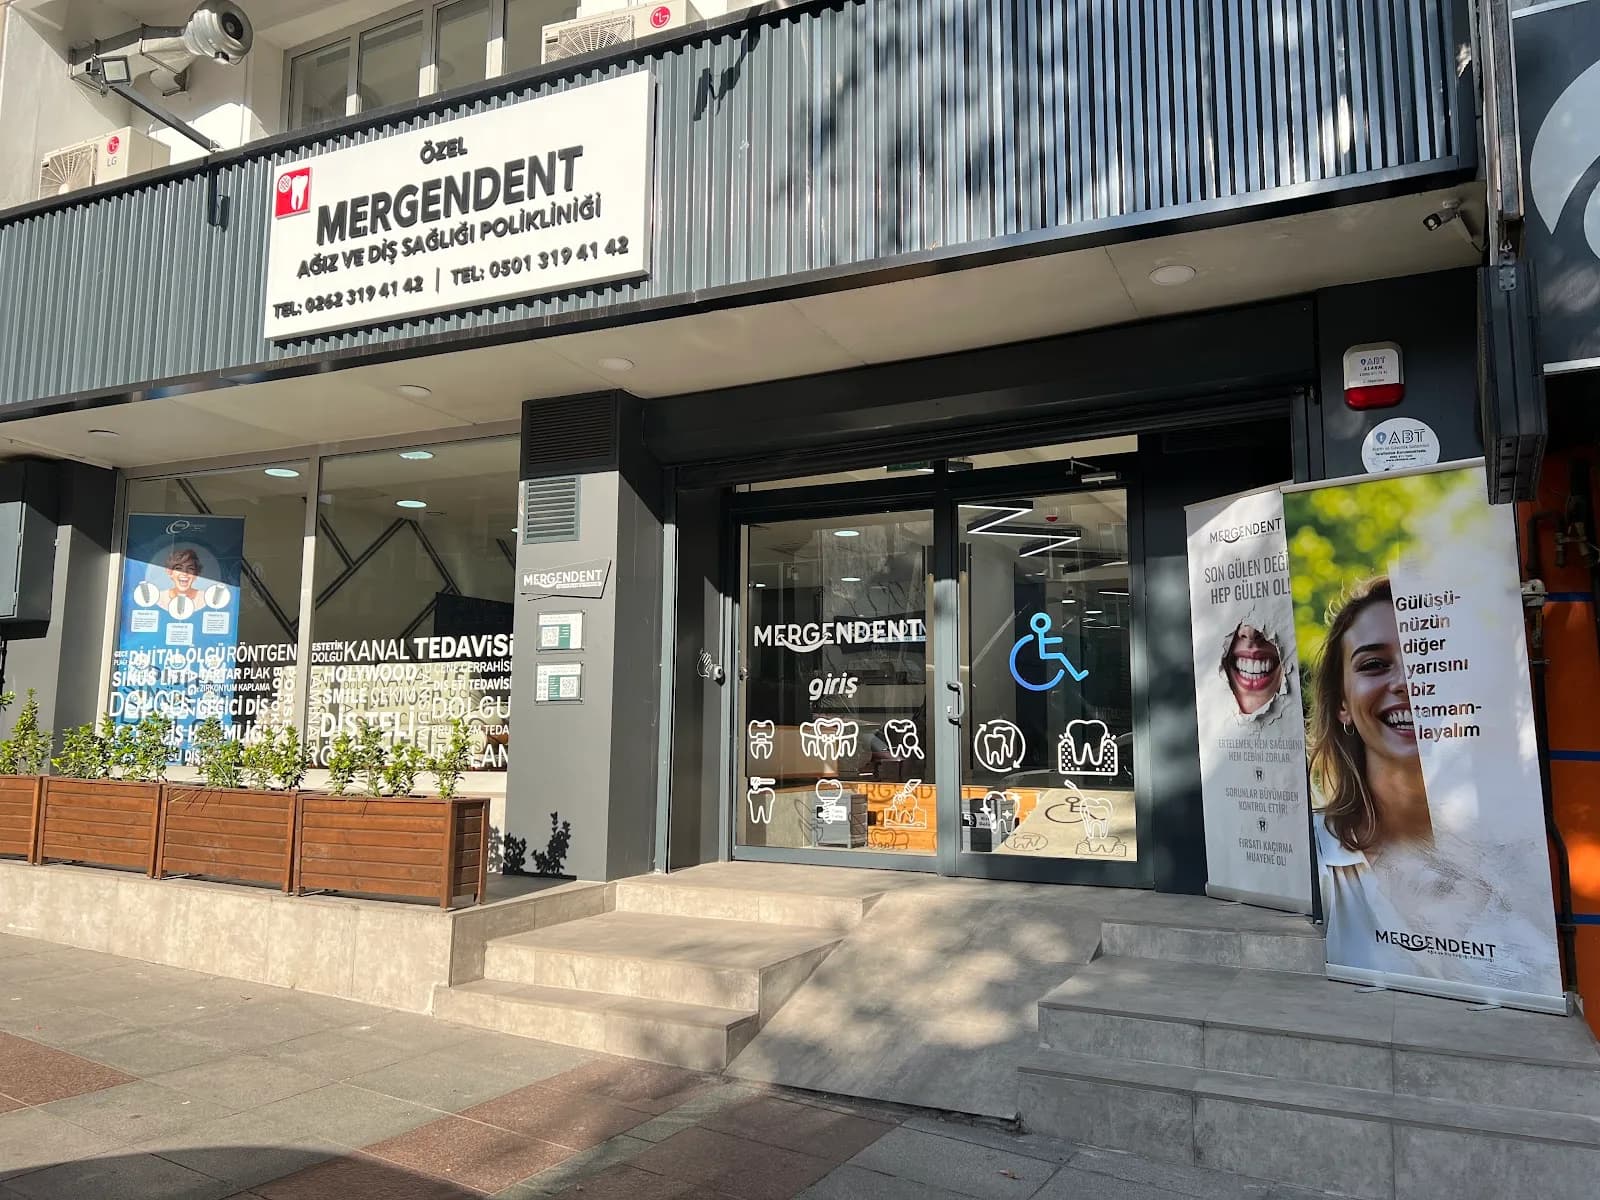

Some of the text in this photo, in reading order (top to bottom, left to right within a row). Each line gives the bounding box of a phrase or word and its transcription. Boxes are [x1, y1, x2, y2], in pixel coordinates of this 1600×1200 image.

[419, 136, 468, 164] ÖZEL
[106, 156, 117, 167] LG
[315, 144, 584, 246] MERGENDENT
[296, 191, 601, 279] AĞIZ VE DİŞ SAĞLIĞI POLİKLİNİĞİ
[450, 235, 629, 286] TEL: 0501 319 41 42
[272, 275, 424, 319] TEL: 0262 319 41 42
[1388, 428, 1426, 445] ABT
[1209, 517, 1282, 544] MERGENDENT
[522, 569, 603, 588] MERGENDENT
[1204, 566, 1225, 583] SON
[1227, 558, 1261, 580] GÜLEN
[1210, 586, 1231, 604] HEP
[1234, 580, 1269, 601] GÜLEN
[1395, 590, 1462, 611] Gülüşü-
[1399, 614, 1450, 633] nüzün
[311, 639, 343, 652] ESTETİK
[753, 618, 923, 653] MERGENDENT
[226, 641, 297, 664] RÖNTGEN
[343, 638, 410, 662] KANAL
[1402, 637, 1446, 656] diğer
[311, 651, 343, 663] DOLGU
[243, 666, 270, 680] PLAK
[1406, 658, 1468, 679] yarısını
[238, 682, 271, 693] KAPLAMA
[808, 672, 858, 701] giriş
[1410, 682, 1436, 697] biz
[432, 696, 511, 719] DOLGU
[1413, 702, 1482, 718] tamam-
[1419, 722, 1481, 742] layalım
[1225, 788, 1258, 799] SORUNLAR
[1238, 801, 1267, 813] KONTROL
[1239, 838, 1262, 851] FIRSATI
[1246, 852, 1275, 865] MUAYENE
[1375, 929, 1497, 958] MERGENDENT
